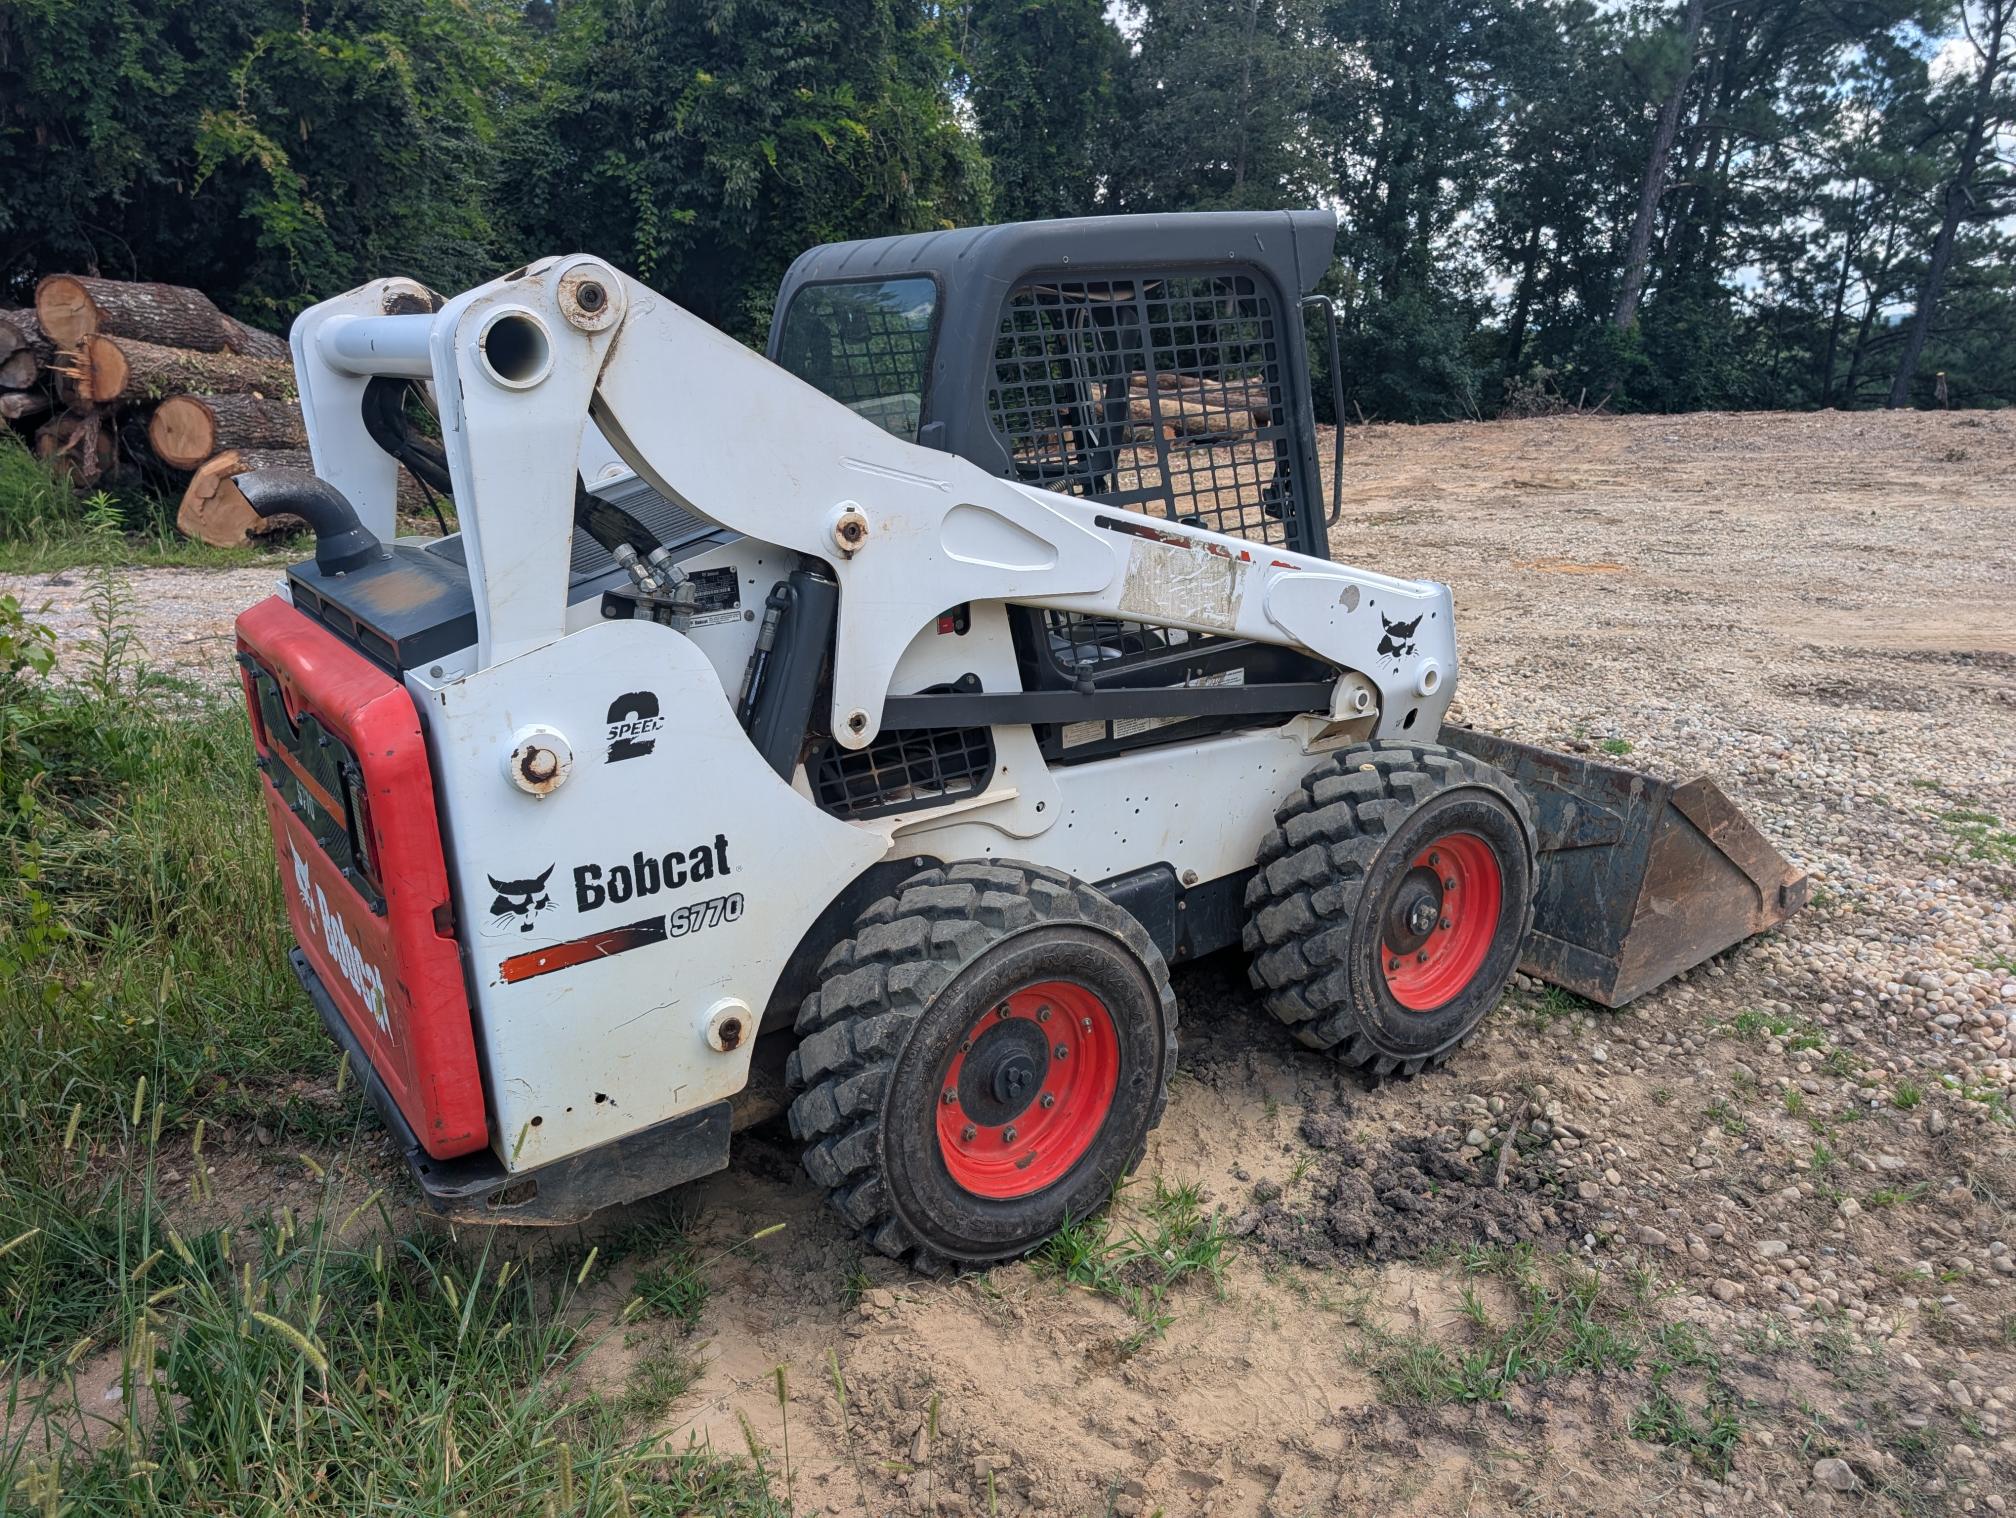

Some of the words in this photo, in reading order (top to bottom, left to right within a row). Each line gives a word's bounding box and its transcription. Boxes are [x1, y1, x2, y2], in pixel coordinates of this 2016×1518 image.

[604, 691, 660, 763] 2
[573, 833, 731, 914] Bobcat
[669, 892, 745, 940] S770
